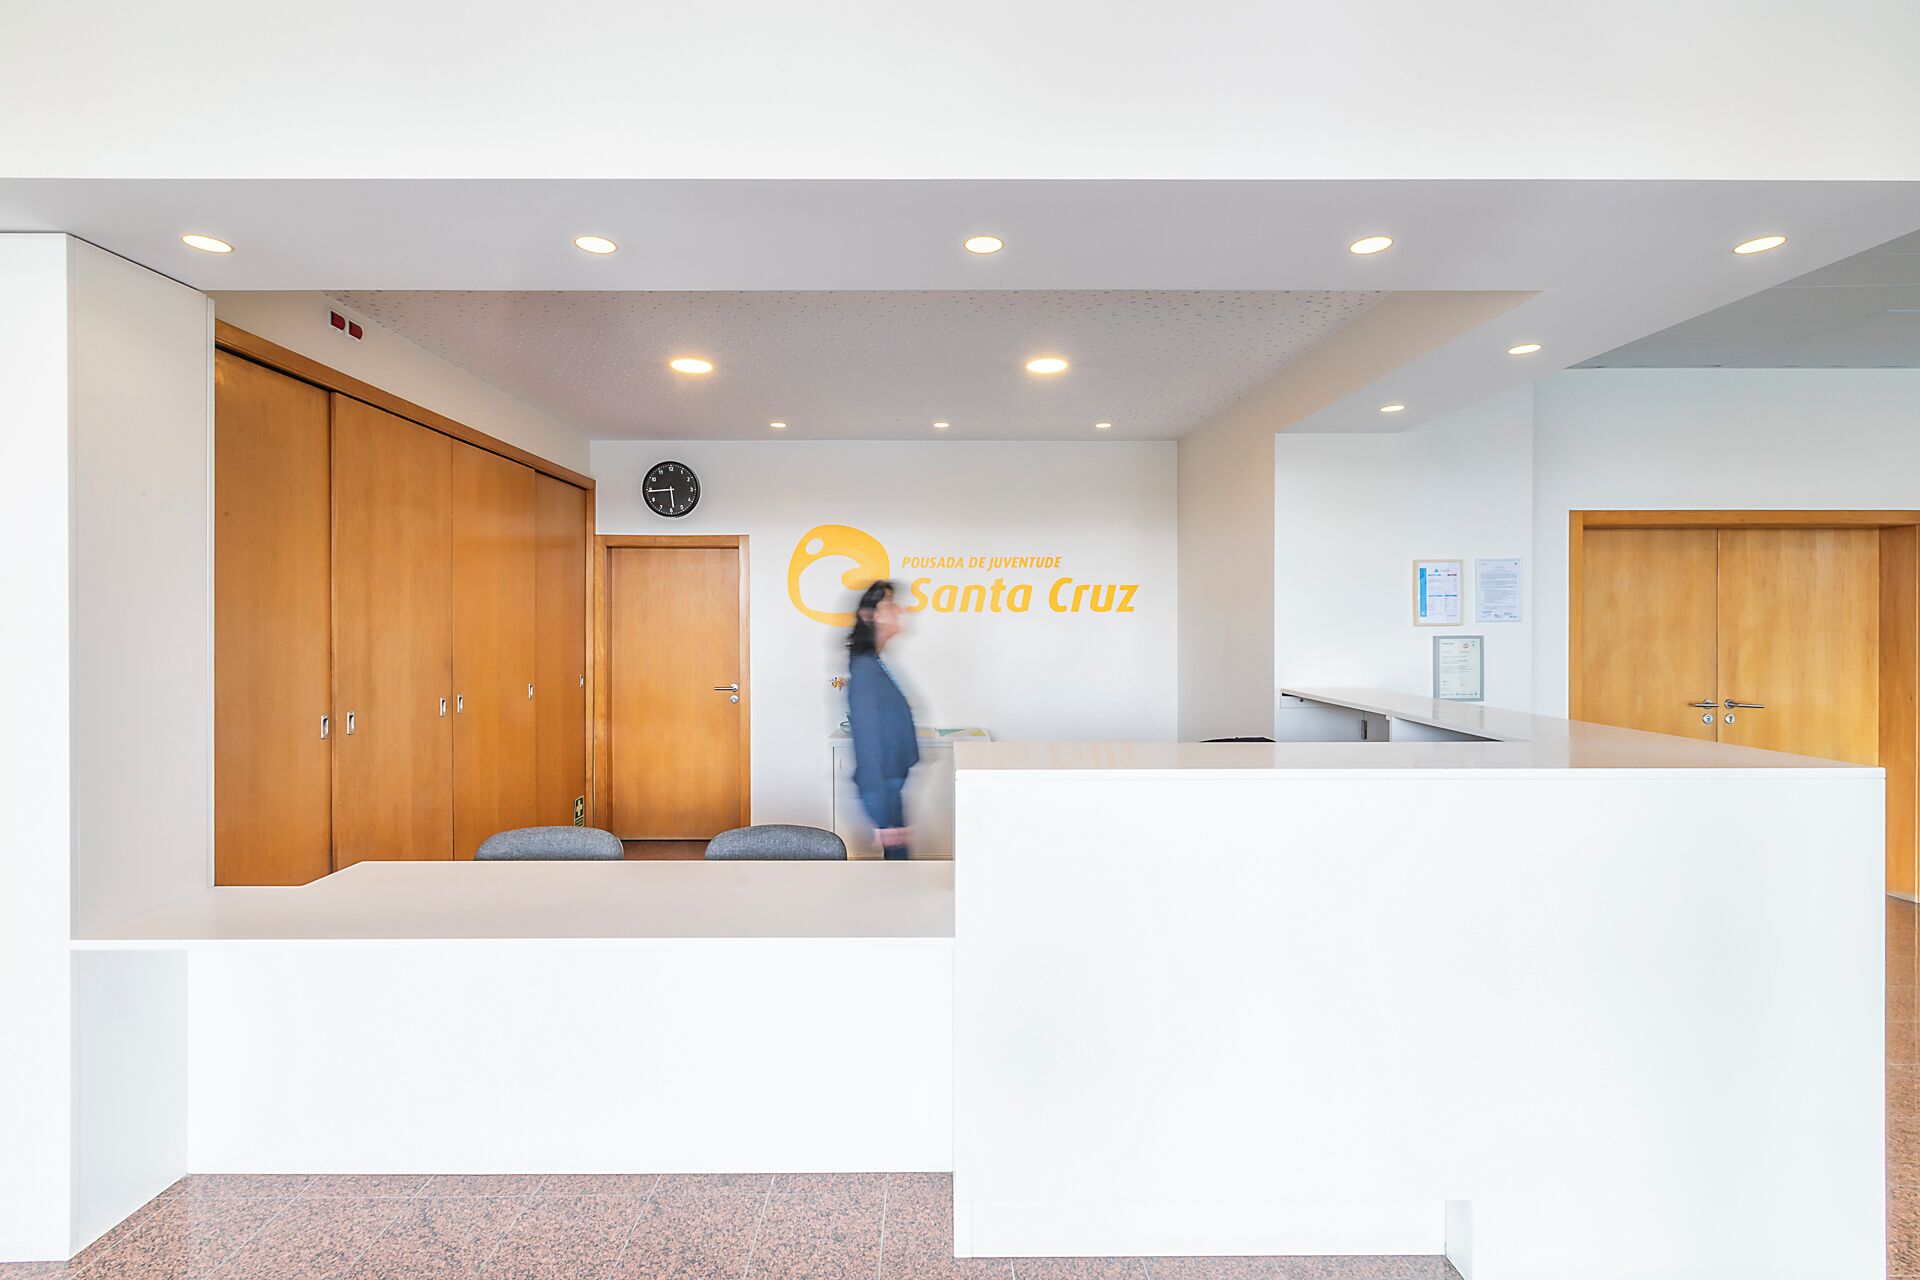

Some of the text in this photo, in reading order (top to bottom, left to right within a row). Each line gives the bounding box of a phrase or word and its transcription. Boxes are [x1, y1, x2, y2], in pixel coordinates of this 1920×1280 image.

[901, 556, 1063, 571] POUSADA DE JUVENTUDE
[906, 577, 1140, 613] Santa Cruz
